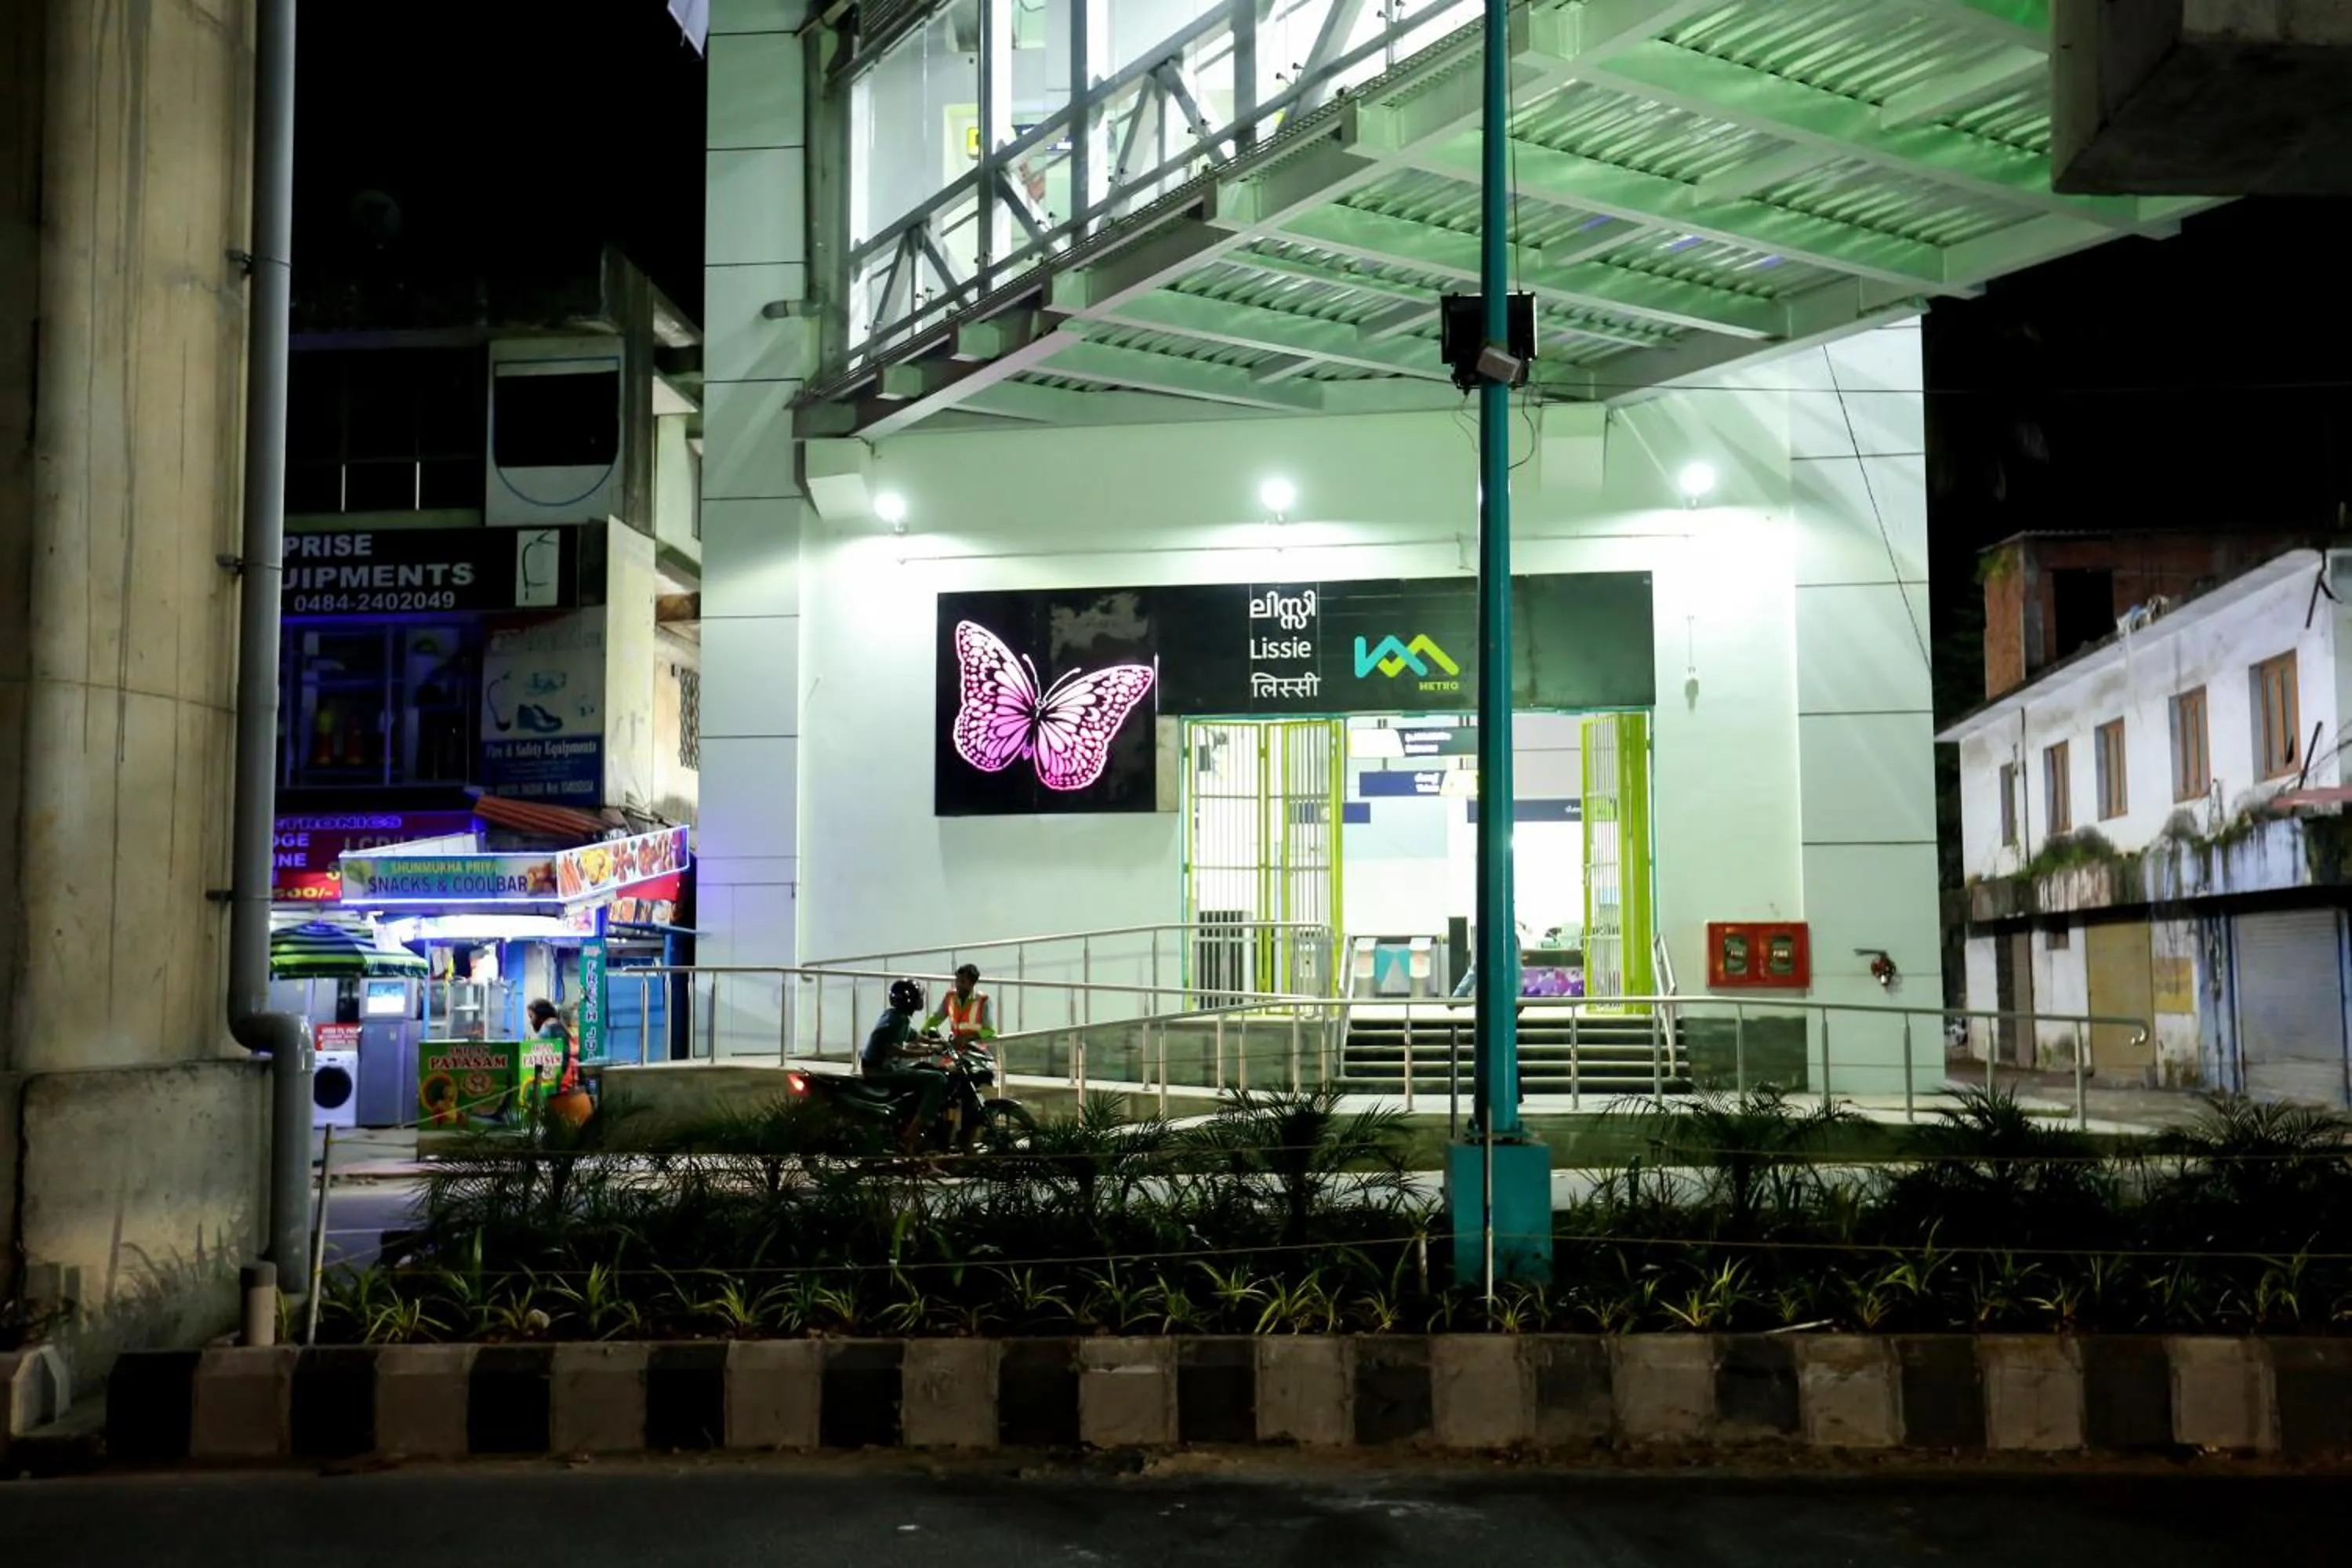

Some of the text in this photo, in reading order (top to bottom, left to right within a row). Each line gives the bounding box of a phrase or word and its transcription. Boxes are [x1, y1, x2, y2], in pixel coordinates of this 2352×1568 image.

[294, 590, 456, 612] 0484-2402049
[1250, 590, 1316, 630] ലിസ്സി
[1250, 637, 1312, 659] Lissie
[1250, 672, 1321, 699] लिस्सी
[515, 741, 543, 759] Safety
[368, 875, 430, 894] SNACKS
[437, 876, 448, 893] &
[430, 1055, 507, 1069] PAYASAM
